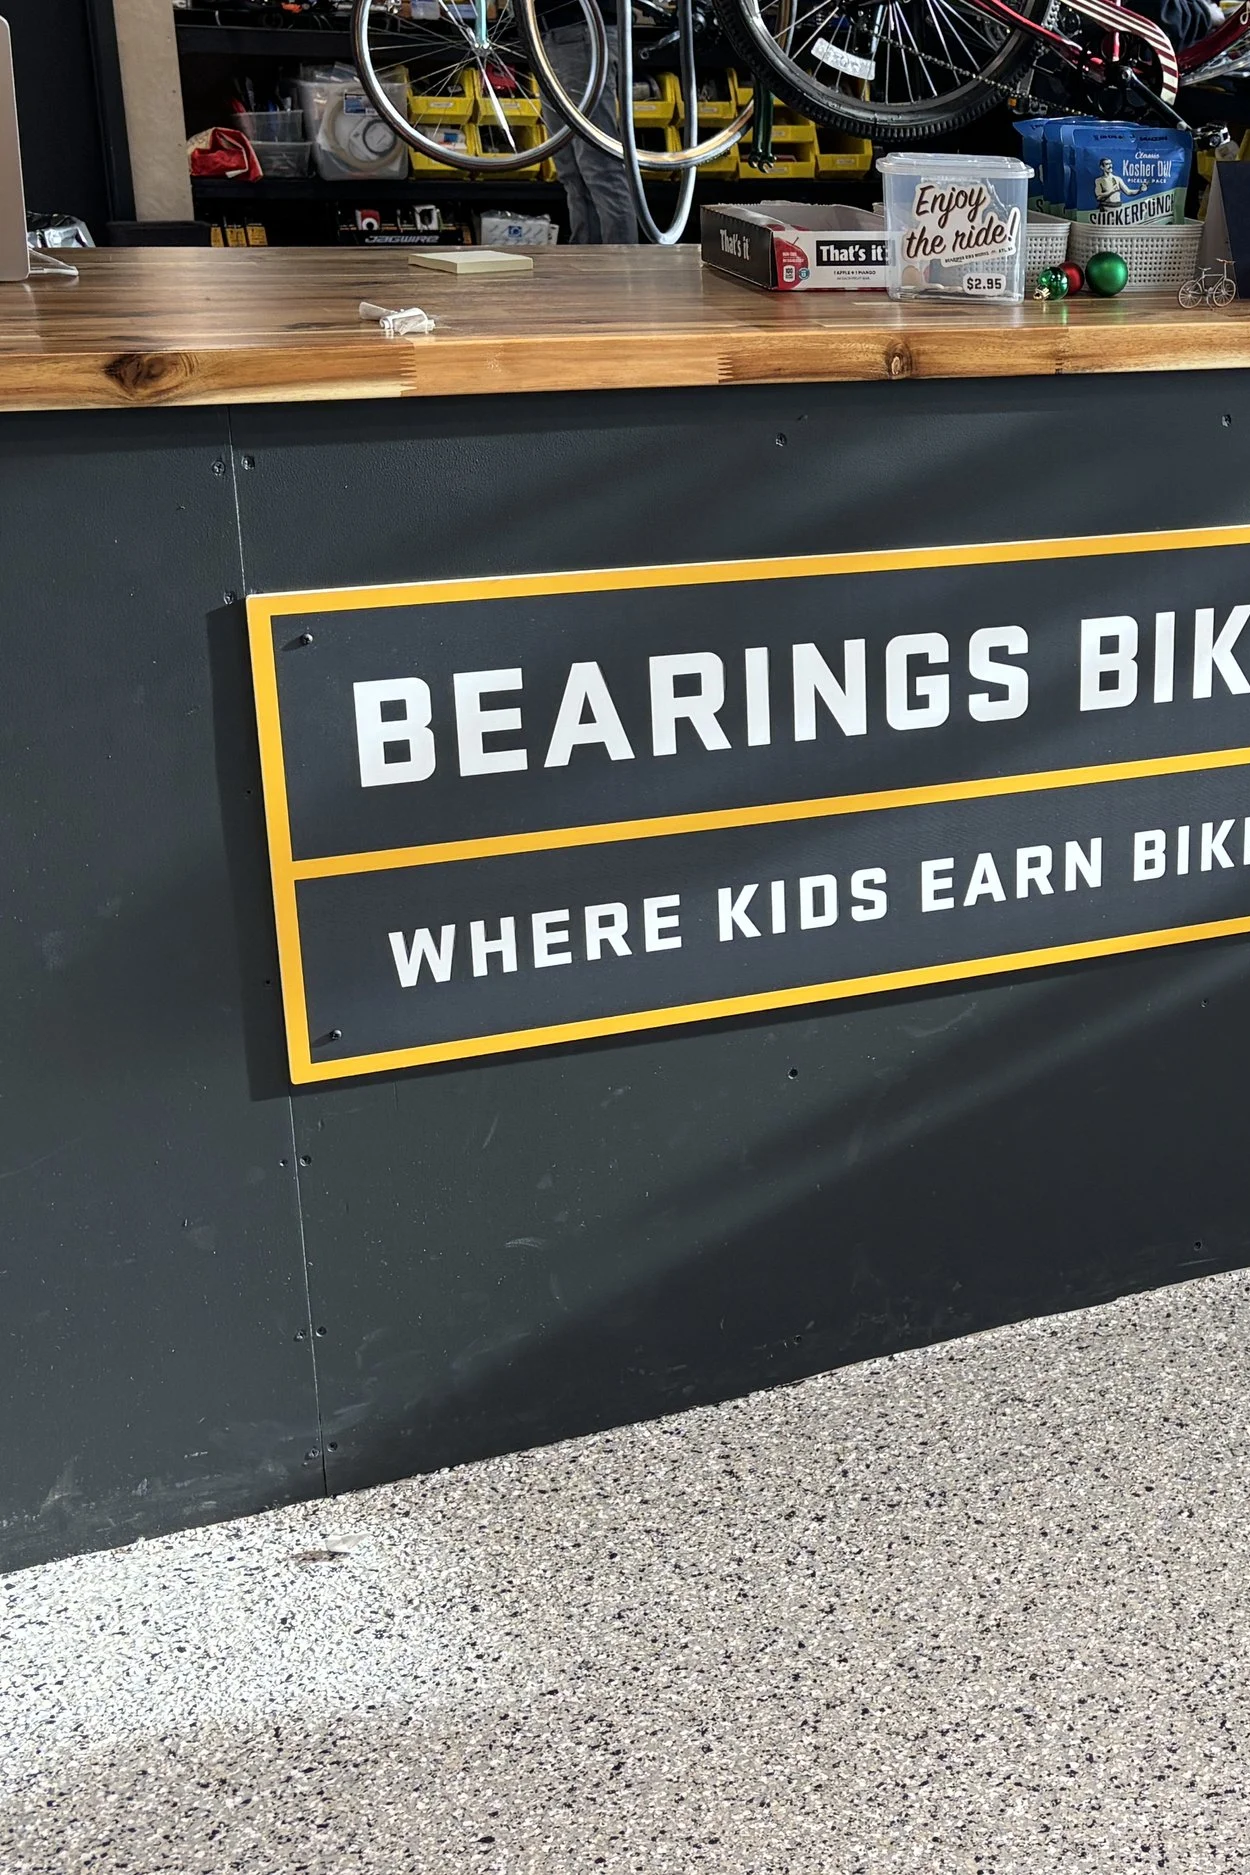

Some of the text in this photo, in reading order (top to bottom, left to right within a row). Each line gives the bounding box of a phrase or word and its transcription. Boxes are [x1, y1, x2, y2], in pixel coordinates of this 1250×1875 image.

[1123, 159, 1172, 178] Kosher Dill
[915, 184, 987, 229] Enjoy
[719, 229, 741, 258] That's
[820, 244, 867, 262] That's
[906, 211, 1017, 259] the ride!
[966, 276, 1002, 290] $2.95
[353, 626, 1029, 787] BEARINGS
[388, 894, 682, 988] WHERE
[718, 867, 888, 942] KIDS
[921, 837, 1102, 913] EARN
